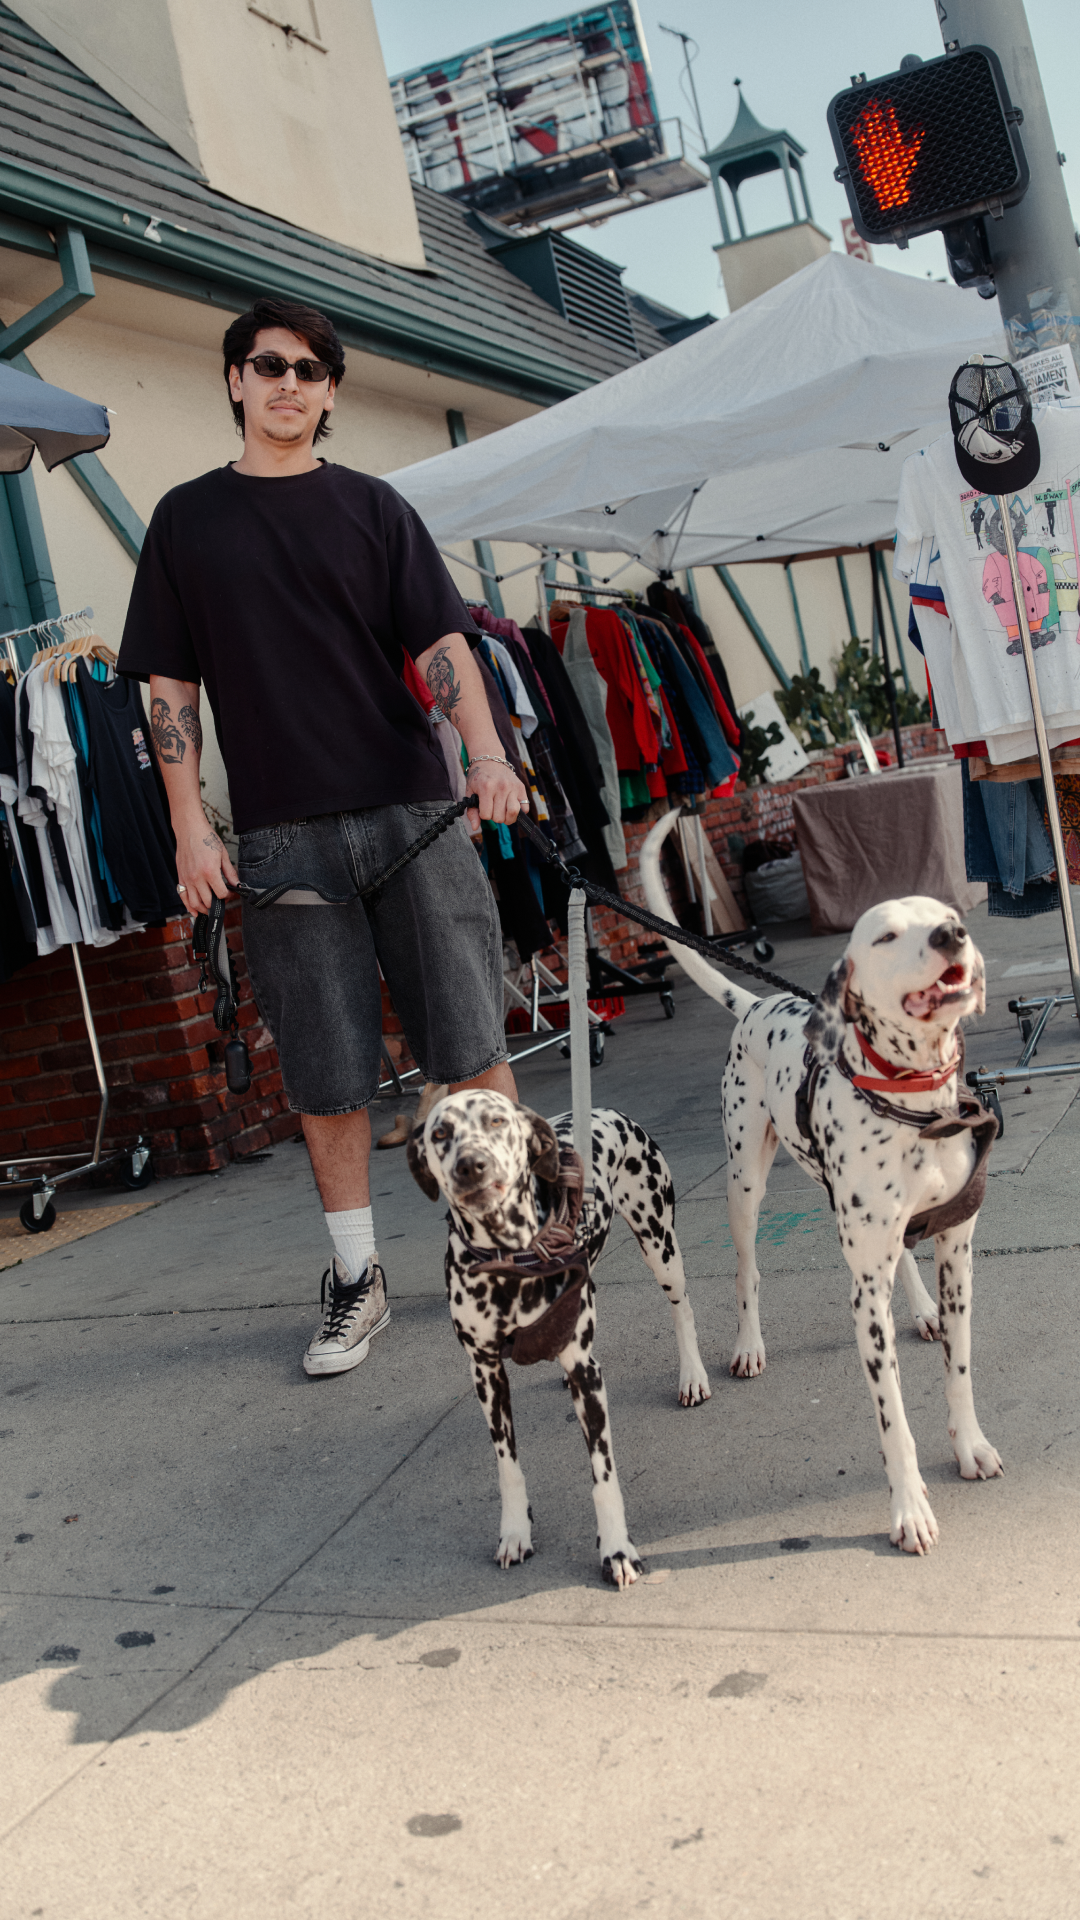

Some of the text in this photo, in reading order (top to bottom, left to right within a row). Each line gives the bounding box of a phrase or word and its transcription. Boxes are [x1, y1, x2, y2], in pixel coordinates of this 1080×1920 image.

[1030, 357, 1050, 368] TAKES
[1052, 353, 1064, 362] ALL
[1039, 360, 1064, 373] SCISSORS
[1026, 366, 1067, 389] RNAMENT
